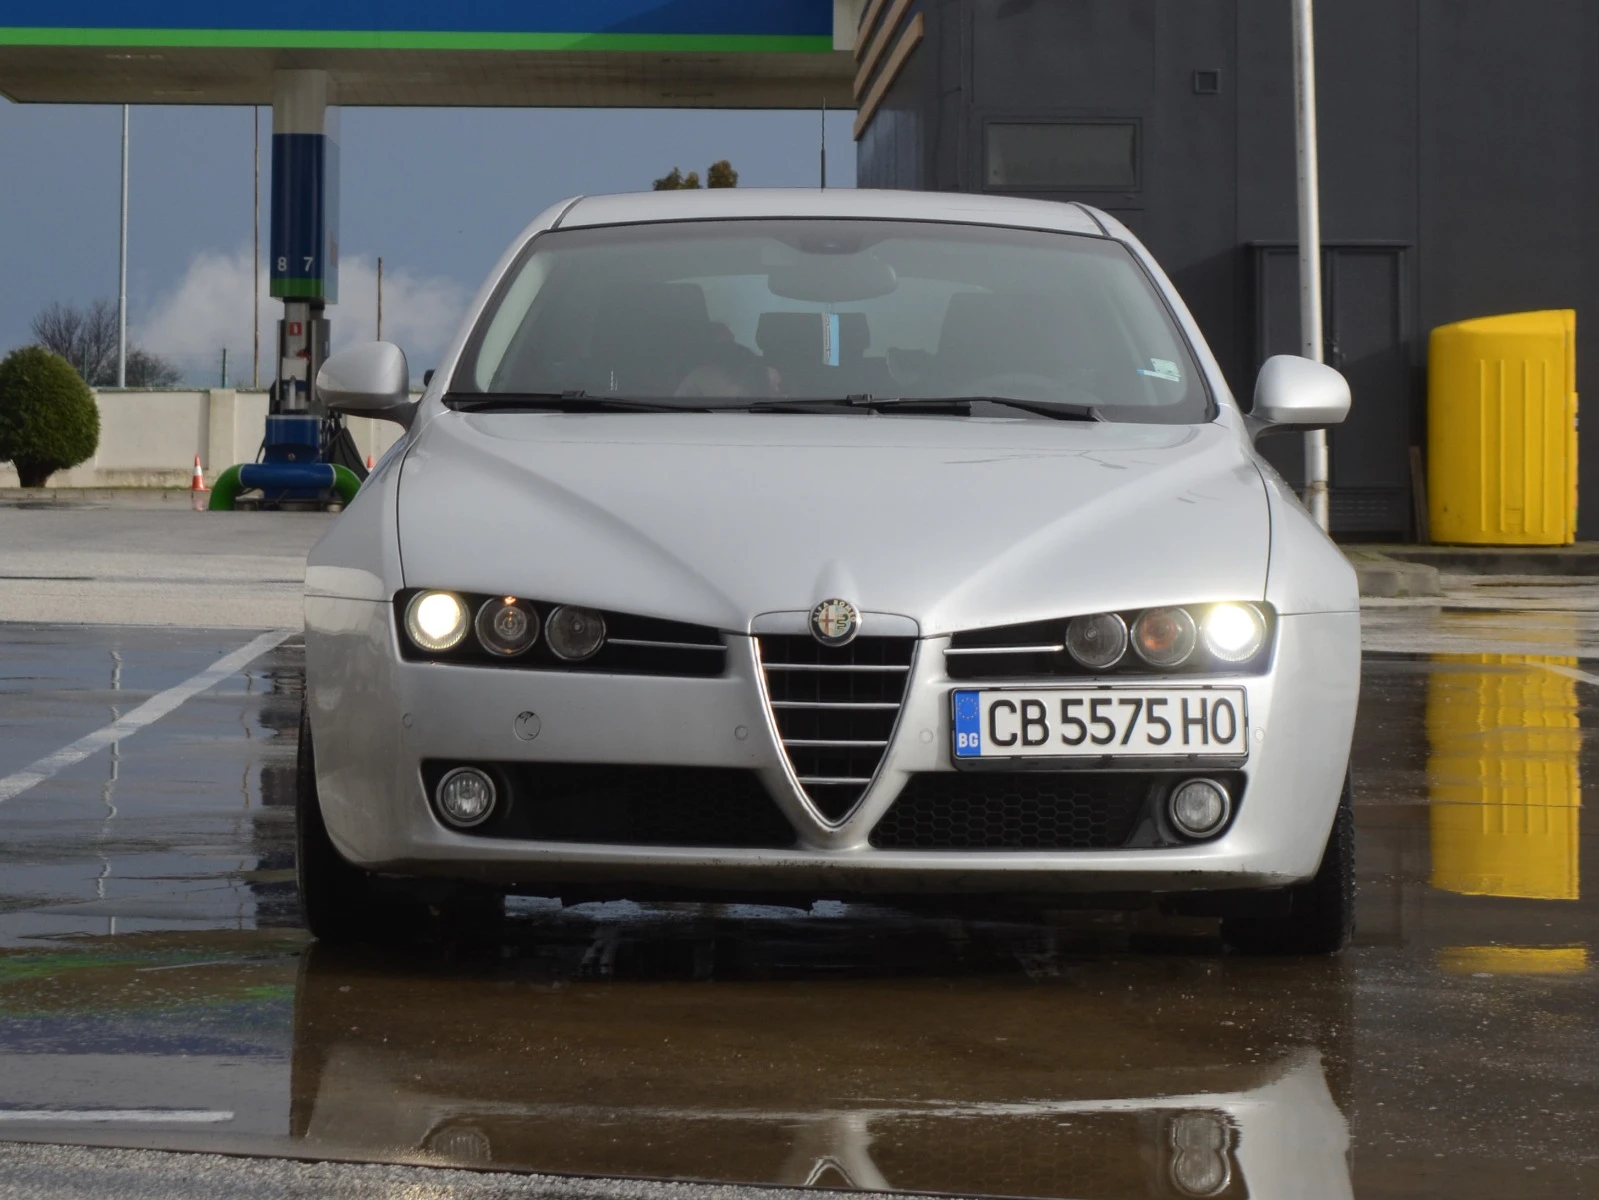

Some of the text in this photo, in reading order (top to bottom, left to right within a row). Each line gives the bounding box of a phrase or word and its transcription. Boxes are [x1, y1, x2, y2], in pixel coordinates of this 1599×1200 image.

[277, 256, 314, 272] 8 7
[988, 697, 1237, 747] CB 5575 HO
[957, 732, 979, 748] BG
